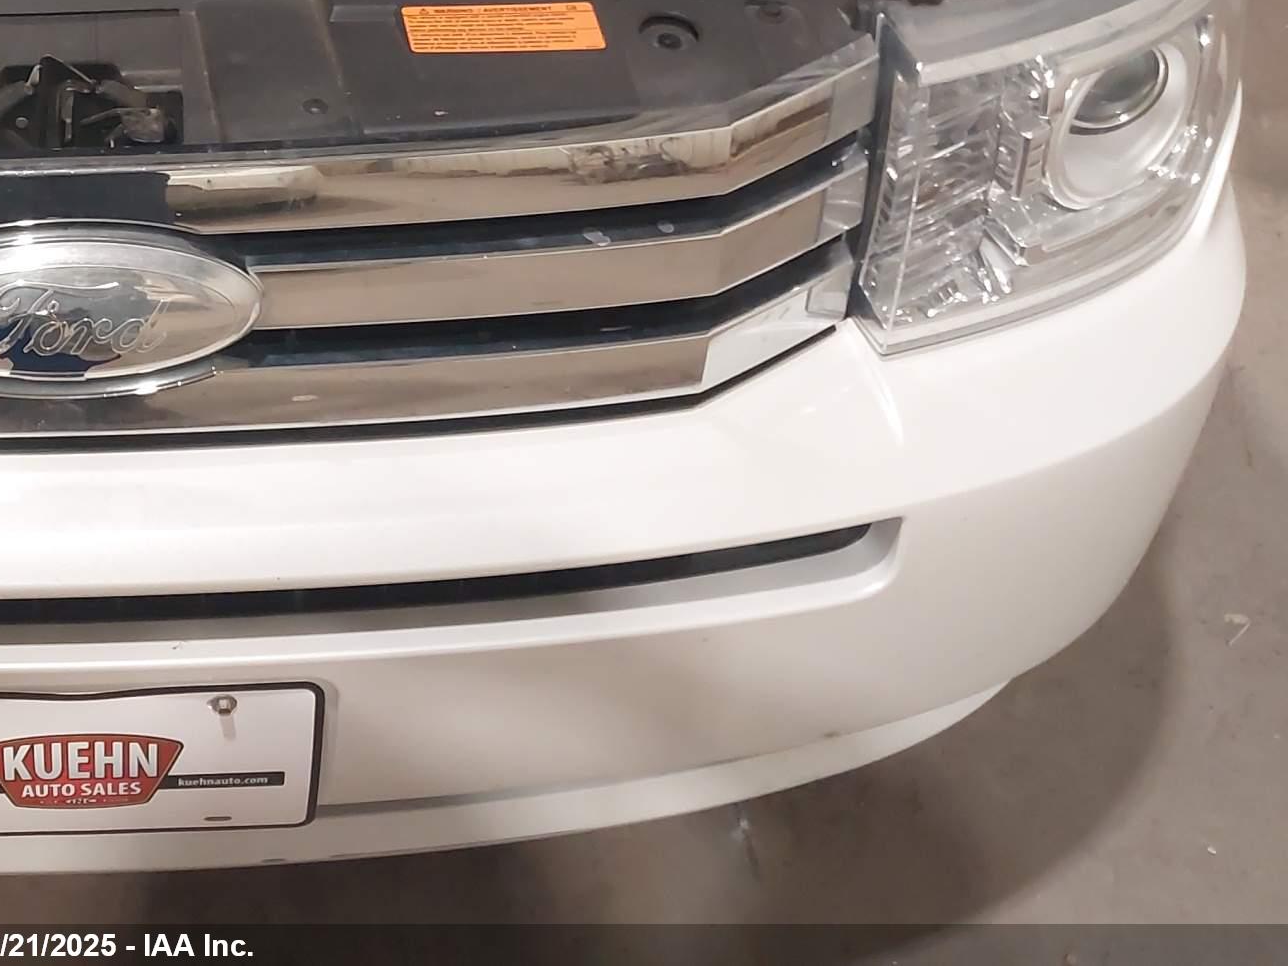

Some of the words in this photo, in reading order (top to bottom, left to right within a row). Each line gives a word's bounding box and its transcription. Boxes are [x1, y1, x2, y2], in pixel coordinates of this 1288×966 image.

[2, 740, 158, 781] KUEHN
[21, 783, 76, 798] AUTO
[80, 781, 142, 796] SALES
[178, 776, 269, 788] kuehnauto.com
